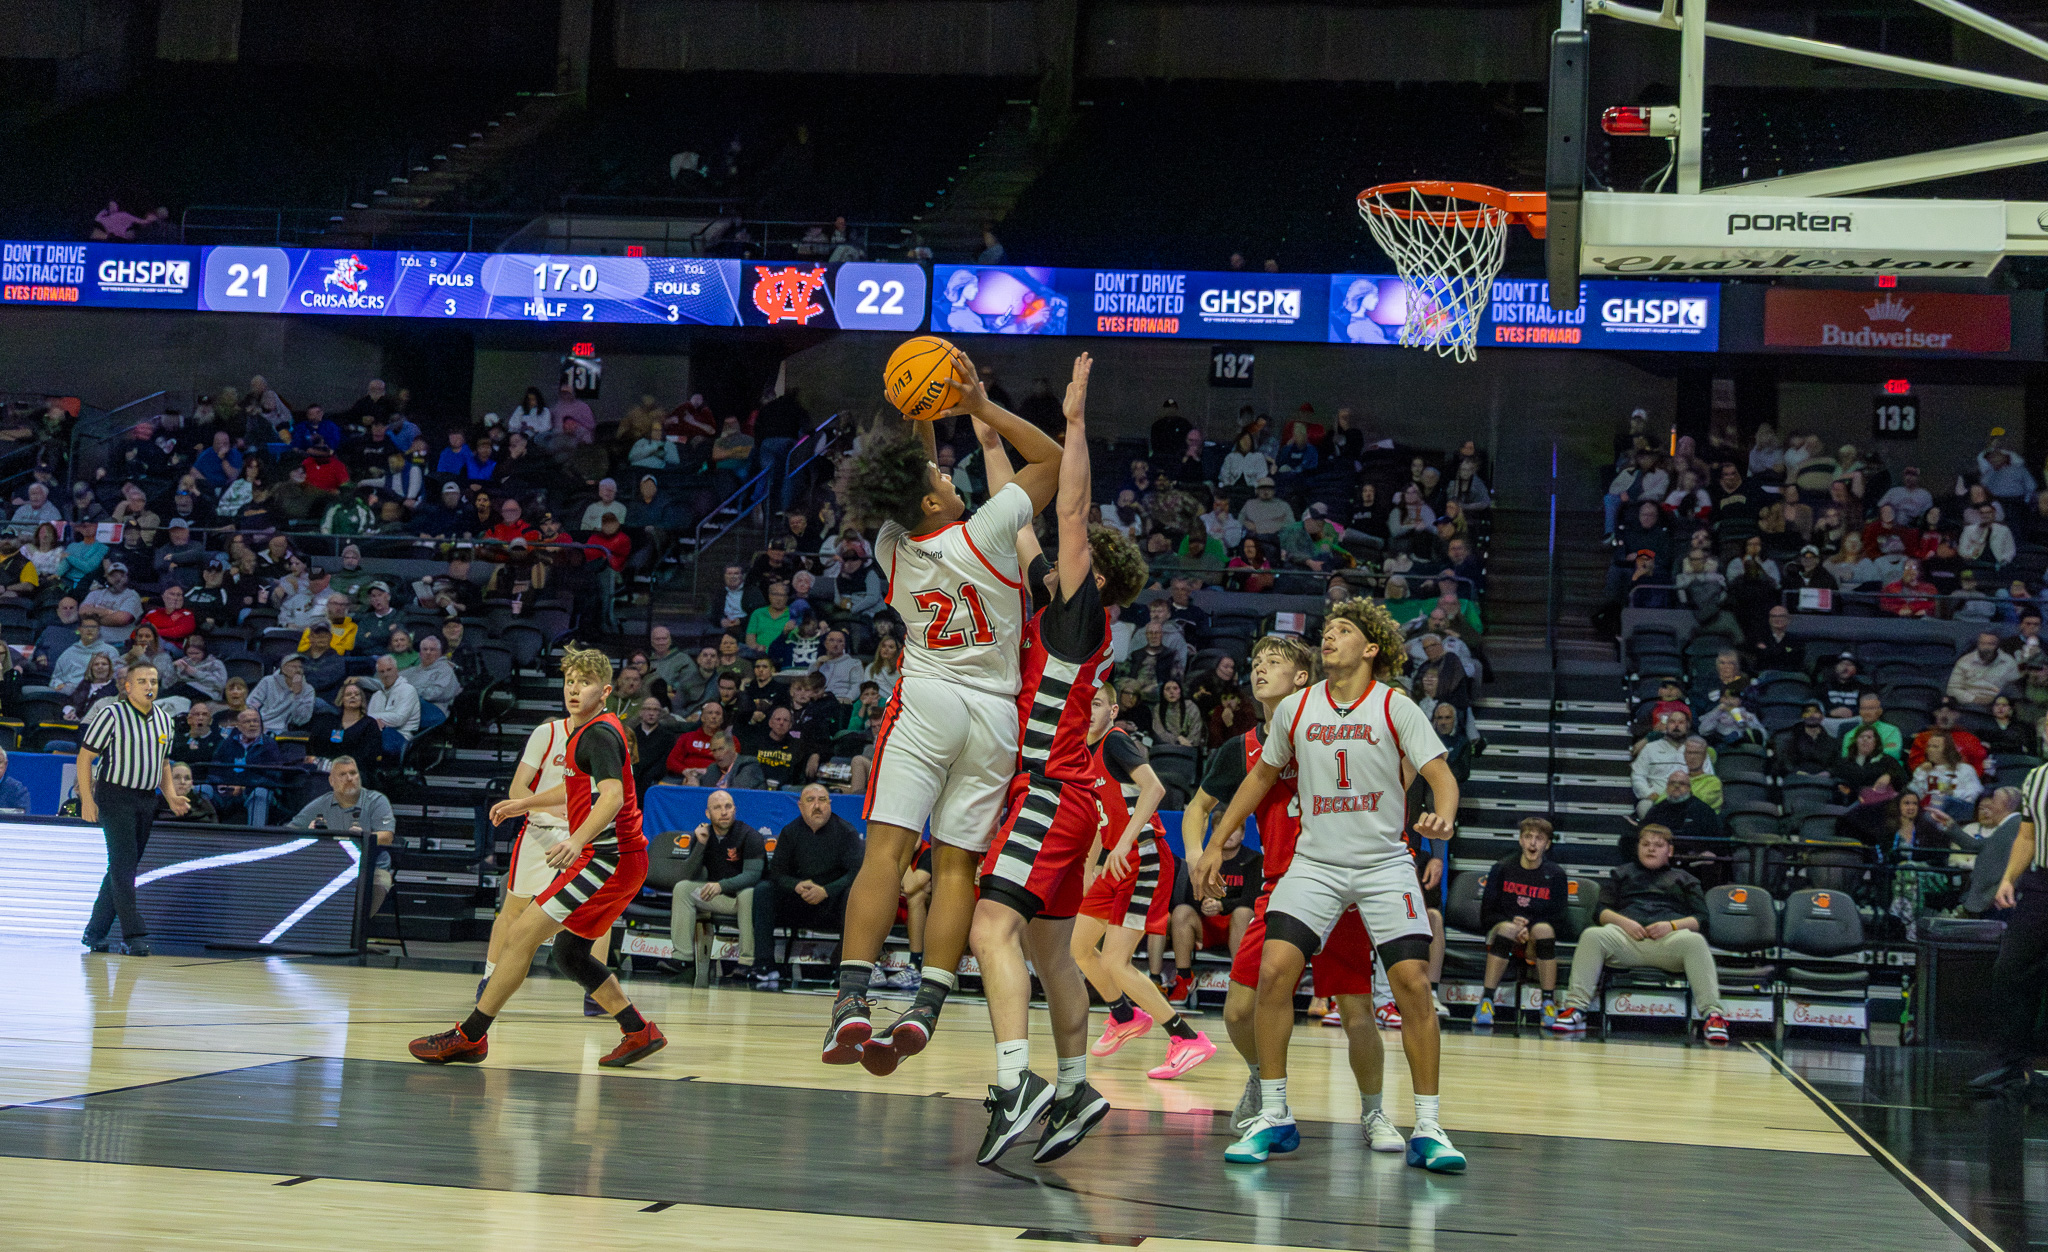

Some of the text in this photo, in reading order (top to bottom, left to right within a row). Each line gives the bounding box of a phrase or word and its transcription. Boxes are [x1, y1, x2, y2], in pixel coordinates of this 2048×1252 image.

[4, 244, 87, 264] DON'T DRIVE
[430, 257, 437, 268] 5
[1593, 254, 1975, 272] Charleston
[3, 263, 84, 283] DISTRACTED
[99, 260, 165, 284] GHSP
[226, 263, 268, 298] 21
[428, 273, 474, 287] FOULS
[533, 262, 598, 292] 17.0
[1094, 272, 1187, 294] DON'T DRIVE
[4, 285, 79, 302] EYES FORWARD
[654, 281, 701, 295] FOULS
[855, 279, 905, 314] 22
[1492, 281, 1539, 302] DON'T
[444, 298, 456, 316] 3
[524, 302, 594, 321] HALF 2
[1094, 293, 1184, 315] DISTRACTED
[1200, 289, 1274, 313] GHSP
[1601, 299, 1680, 324] GHSP
[667, 304, 679, 322] 3
[1097, 316, 1179, 334] EYES FORWARD
[1495, 326, 1582, 344] EYES FORWARD
[1822, 324, 1953, 348] Budweiser
[1213, 354, 1251, 379] 132
[1876, 405, 1915, 431] 133
[910, 582, 997, 651] 21
[1306, 722, 1380, 746] GREATER
[1335, 749, 1351, 789] 1
[1312, 791, 1384, 816] BECKLEY
[1403, 892, 1417, 919] 1
